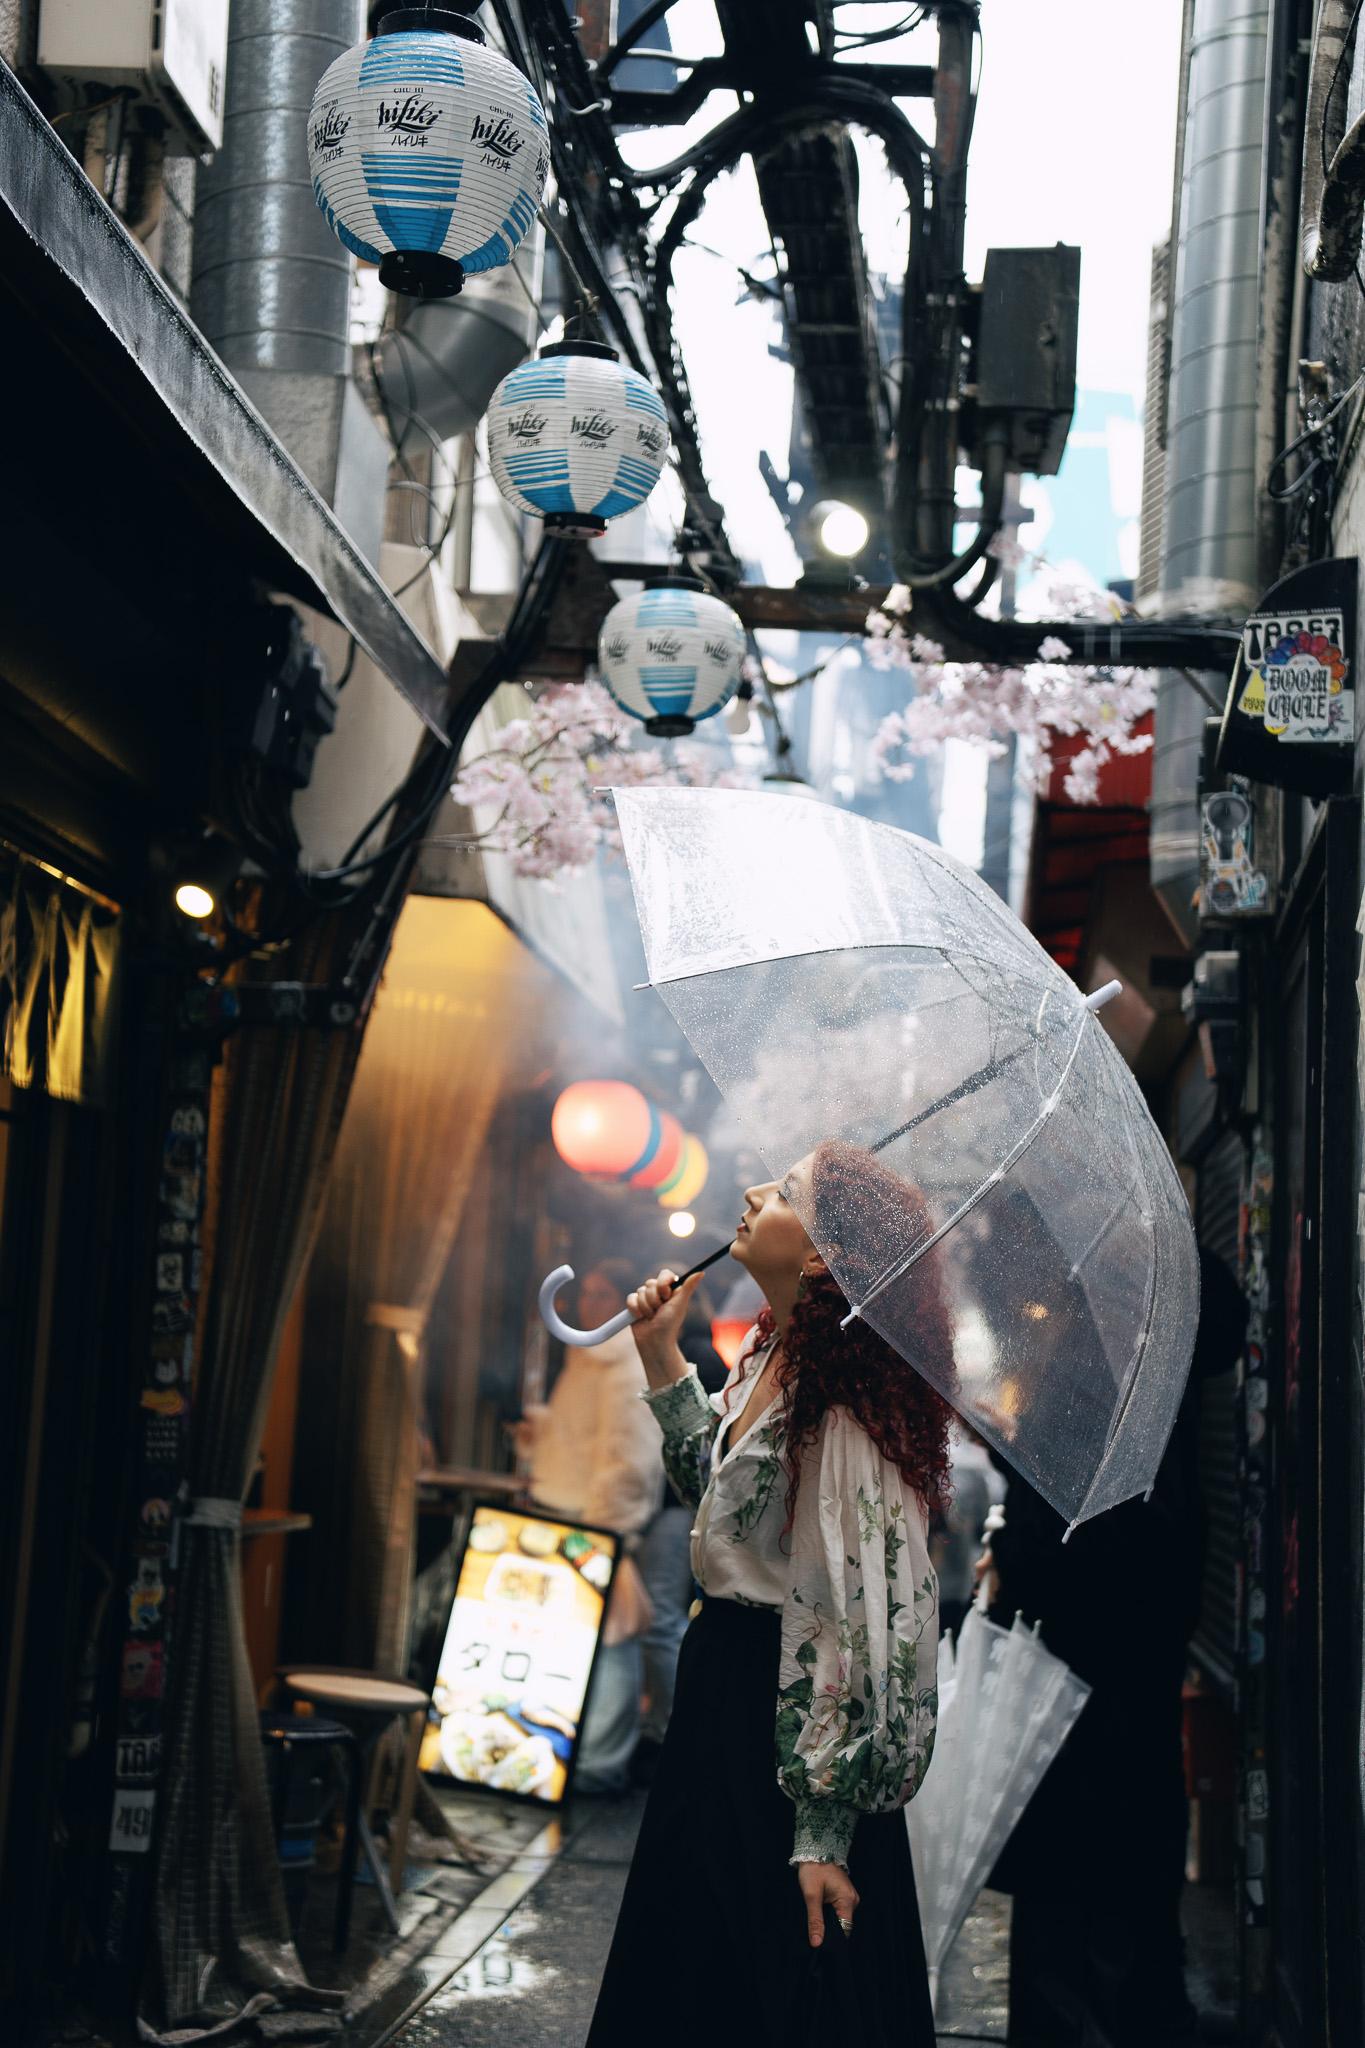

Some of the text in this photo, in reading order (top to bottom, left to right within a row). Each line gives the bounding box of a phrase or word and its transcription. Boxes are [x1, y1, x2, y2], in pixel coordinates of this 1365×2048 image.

[391, 135, 428, 147] ハイリキ
[480, 153, 511, 172] ハイリキ
[1269, 668, 1328, 692] DOOM
[1268, 695, 1327, 719] CYCLE
